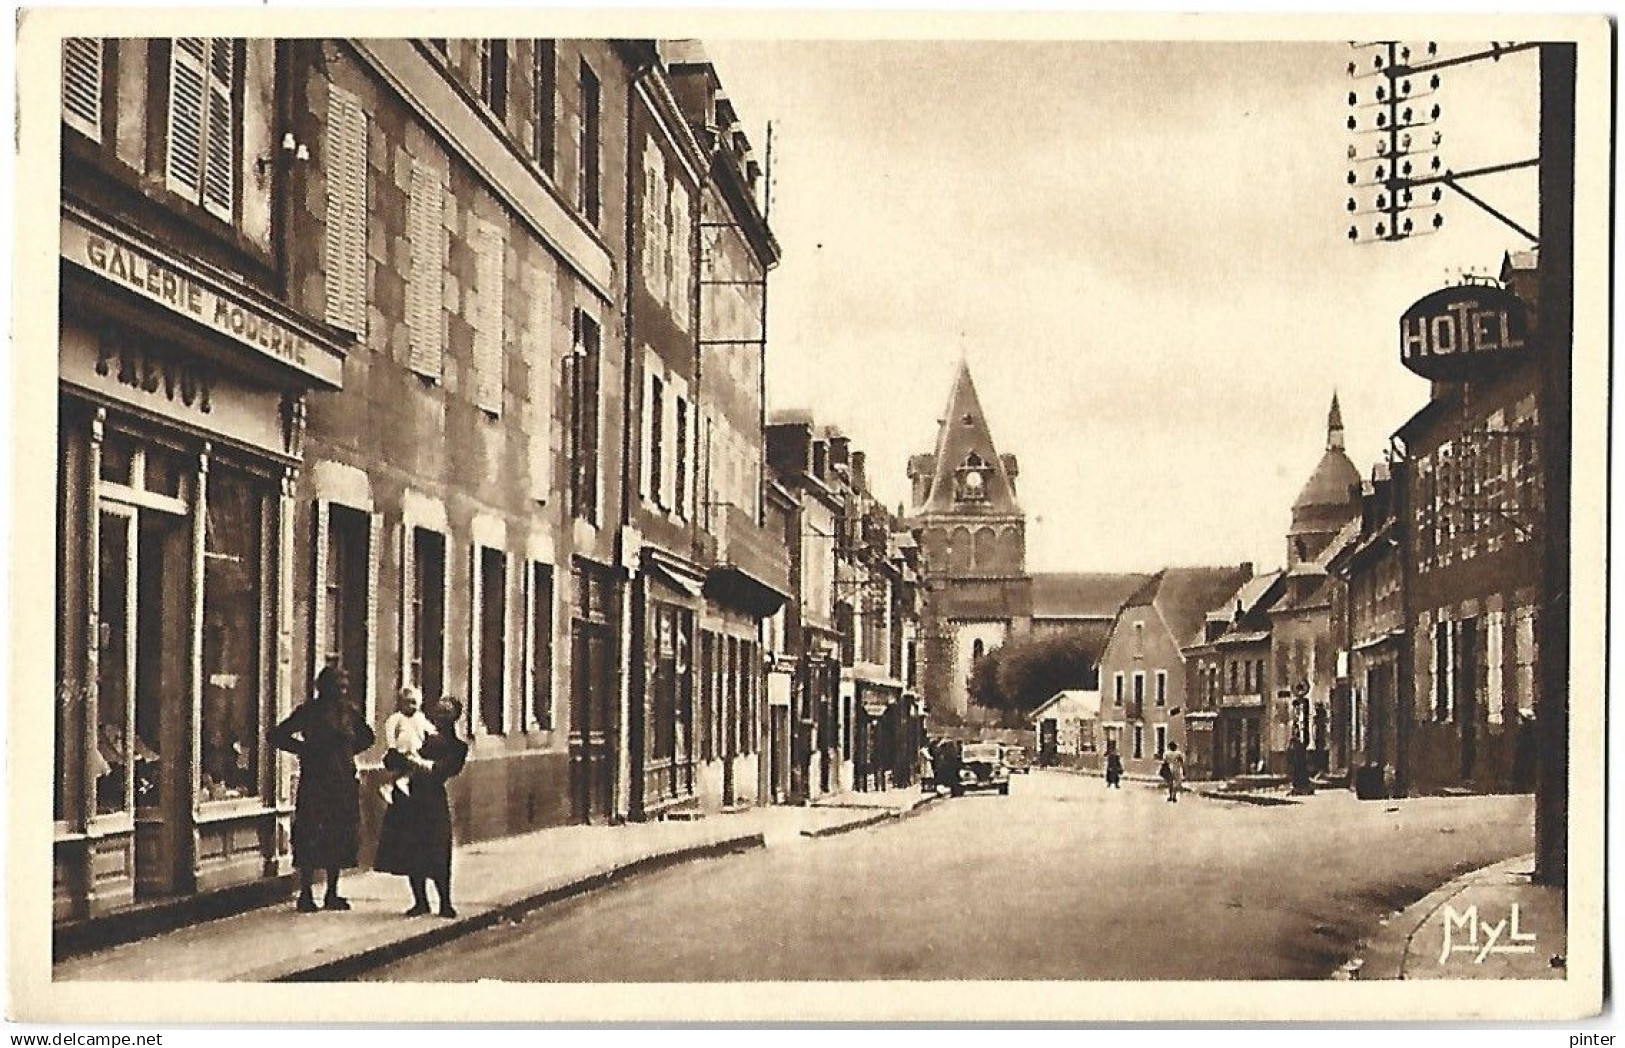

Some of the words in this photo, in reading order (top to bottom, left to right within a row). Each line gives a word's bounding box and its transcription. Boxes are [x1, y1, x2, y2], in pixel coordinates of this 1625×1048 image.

[87, 235, 202, 315] GALERIE
[214, 296, 307, 367] MODERNE
[1402, 301, 1525, 359] HOTEL
